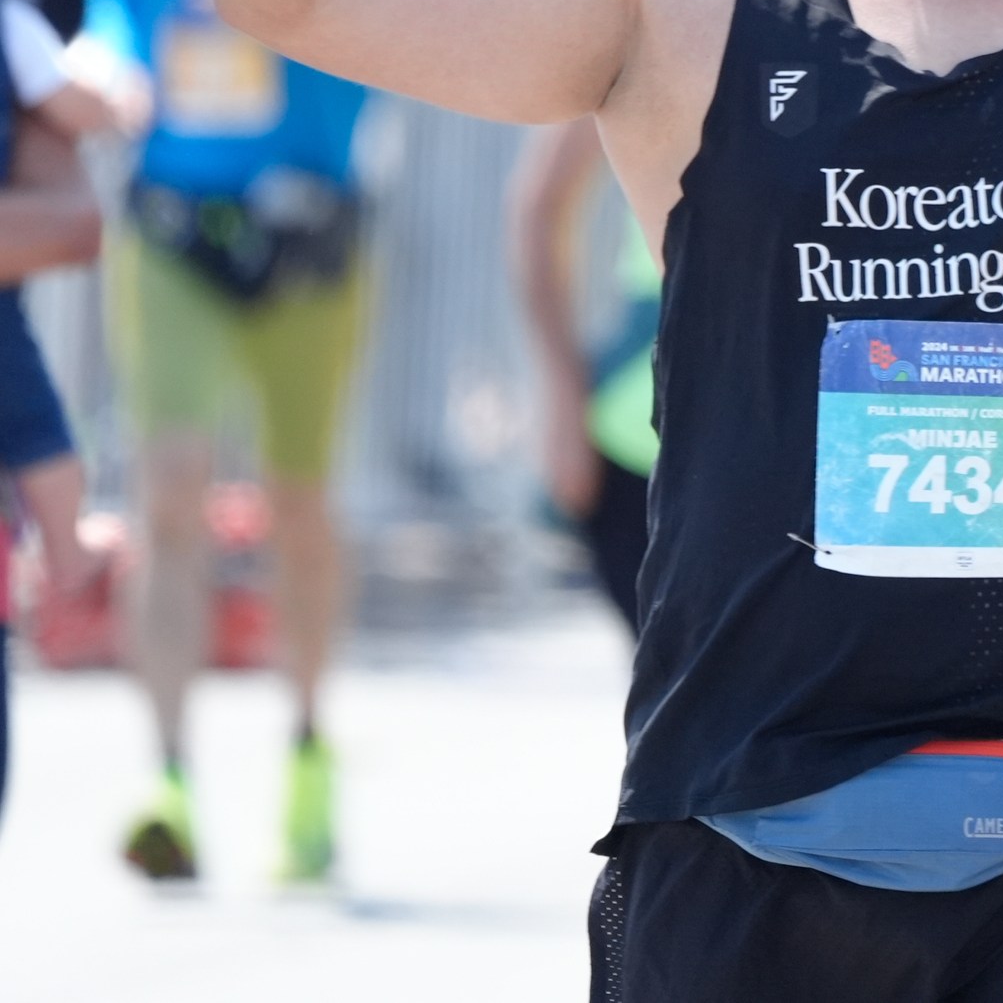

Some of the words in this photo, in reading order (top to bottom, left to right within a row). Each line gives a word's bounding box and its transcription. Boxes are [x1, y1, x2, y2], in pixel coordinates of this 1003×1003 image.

[921, 342, 948, 352] 2024
[921, 354, 950, 366] SAN
[868, 406, 897, 417] FULL
[900, 406, 969, 418] MARATHON
[908, 429, 998, 449] MINJAE
